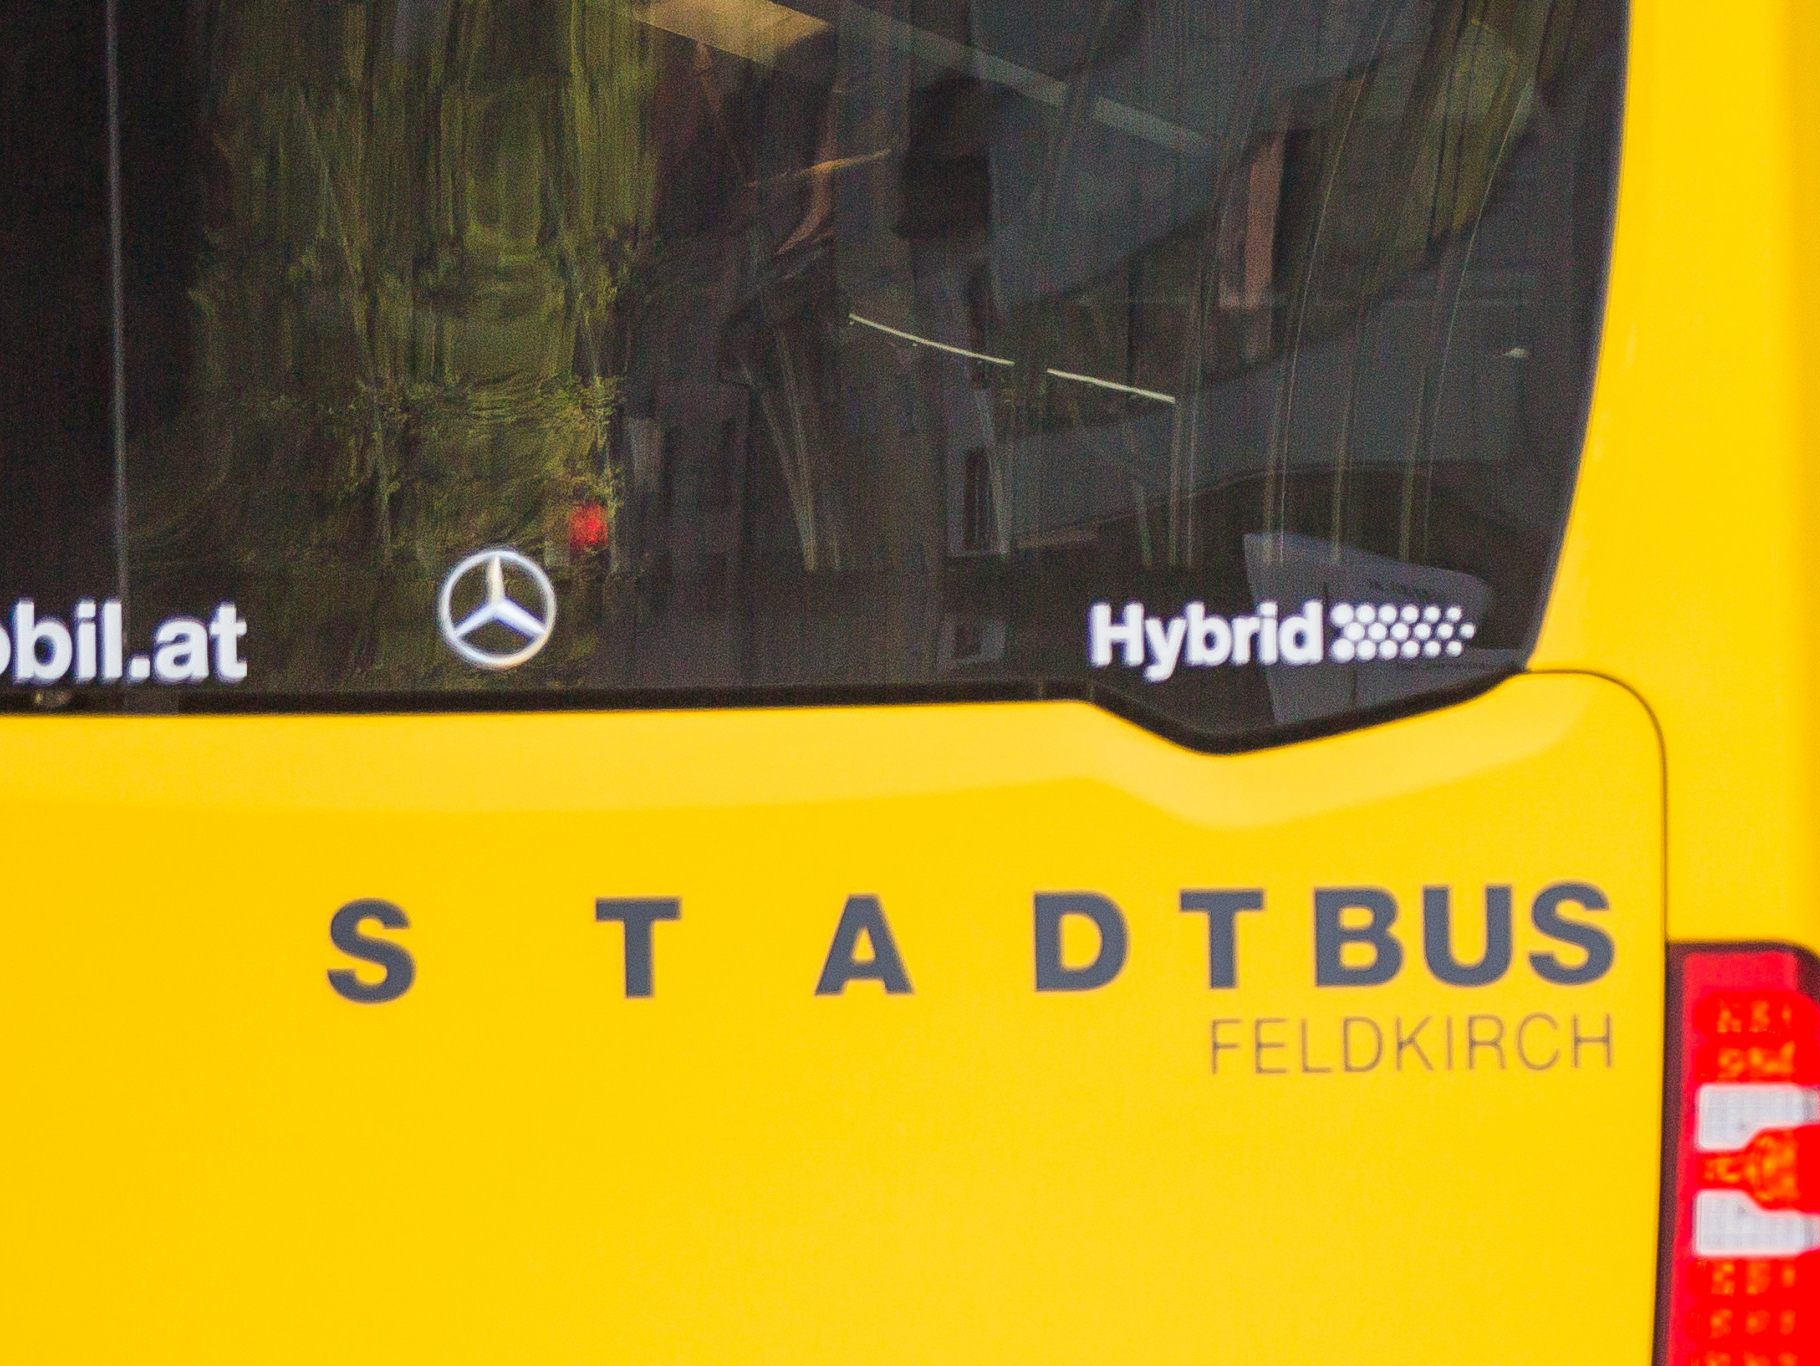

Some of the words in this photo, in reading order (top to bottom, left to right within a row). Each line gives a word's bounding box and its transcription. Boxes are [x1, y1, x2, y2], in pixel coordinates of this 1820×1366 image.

[0, 598, 248, 684] bil.at
[1088, 599, 1324, 682] Hybrid
[1210, 1012, 1614, 1075] FELDKIRCH
